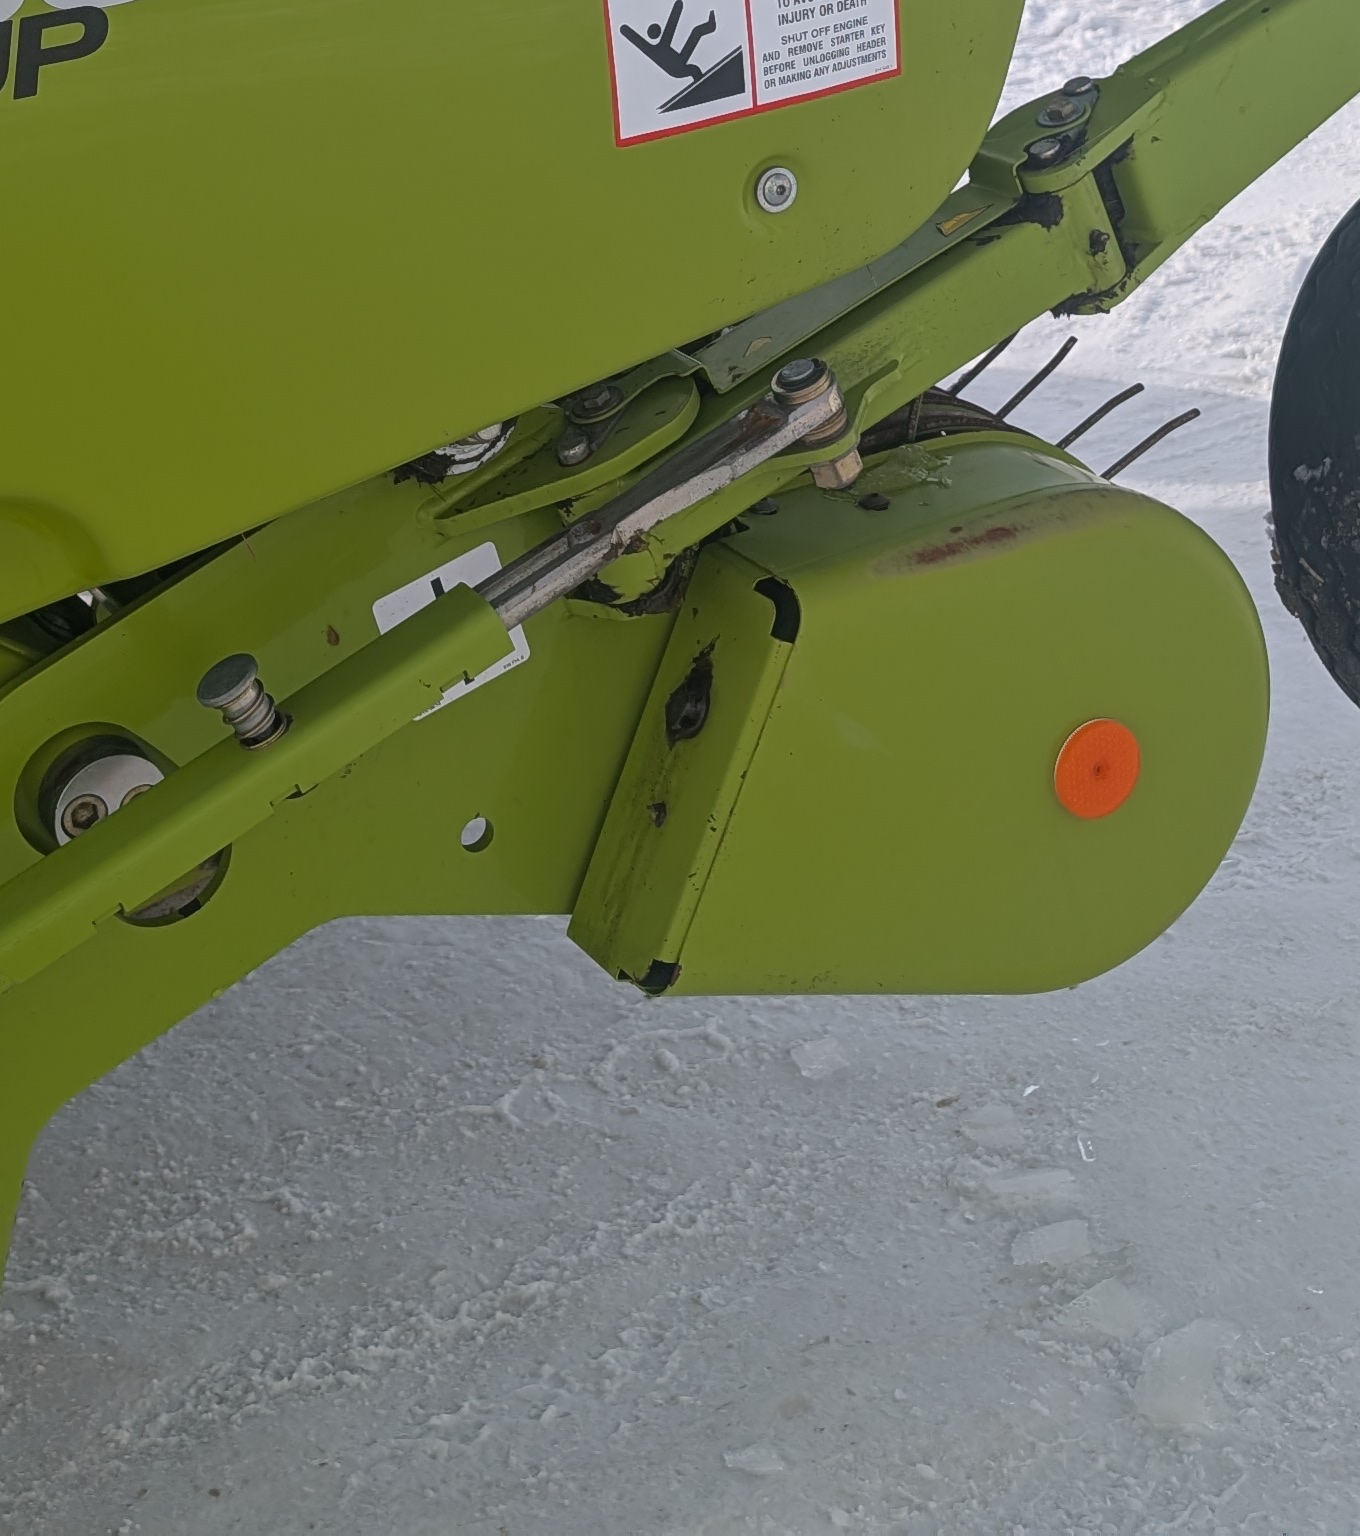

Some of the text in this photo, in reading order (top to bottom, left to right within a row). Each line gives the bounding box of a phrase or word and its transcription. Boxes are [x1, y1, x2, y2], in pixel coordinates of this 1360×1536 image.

[778, 9, 816, 26] INJURY
[819, 2, 834, 16] OR
[781, 16, 868, 45] SHUT OFF ENGINE
[762, 24, 885, 63] AND REMOVE STARTER KEY
[763, 61, 796, 76] BEFORE
[857, 37, 886, 54] HEADER
[764, 78, 776, 89] OR
[779, 70, 811, 86] MAKING
[814, 64, 830, 77] ANY
[832, 49, 886, 73] ADJUSTMENTS
